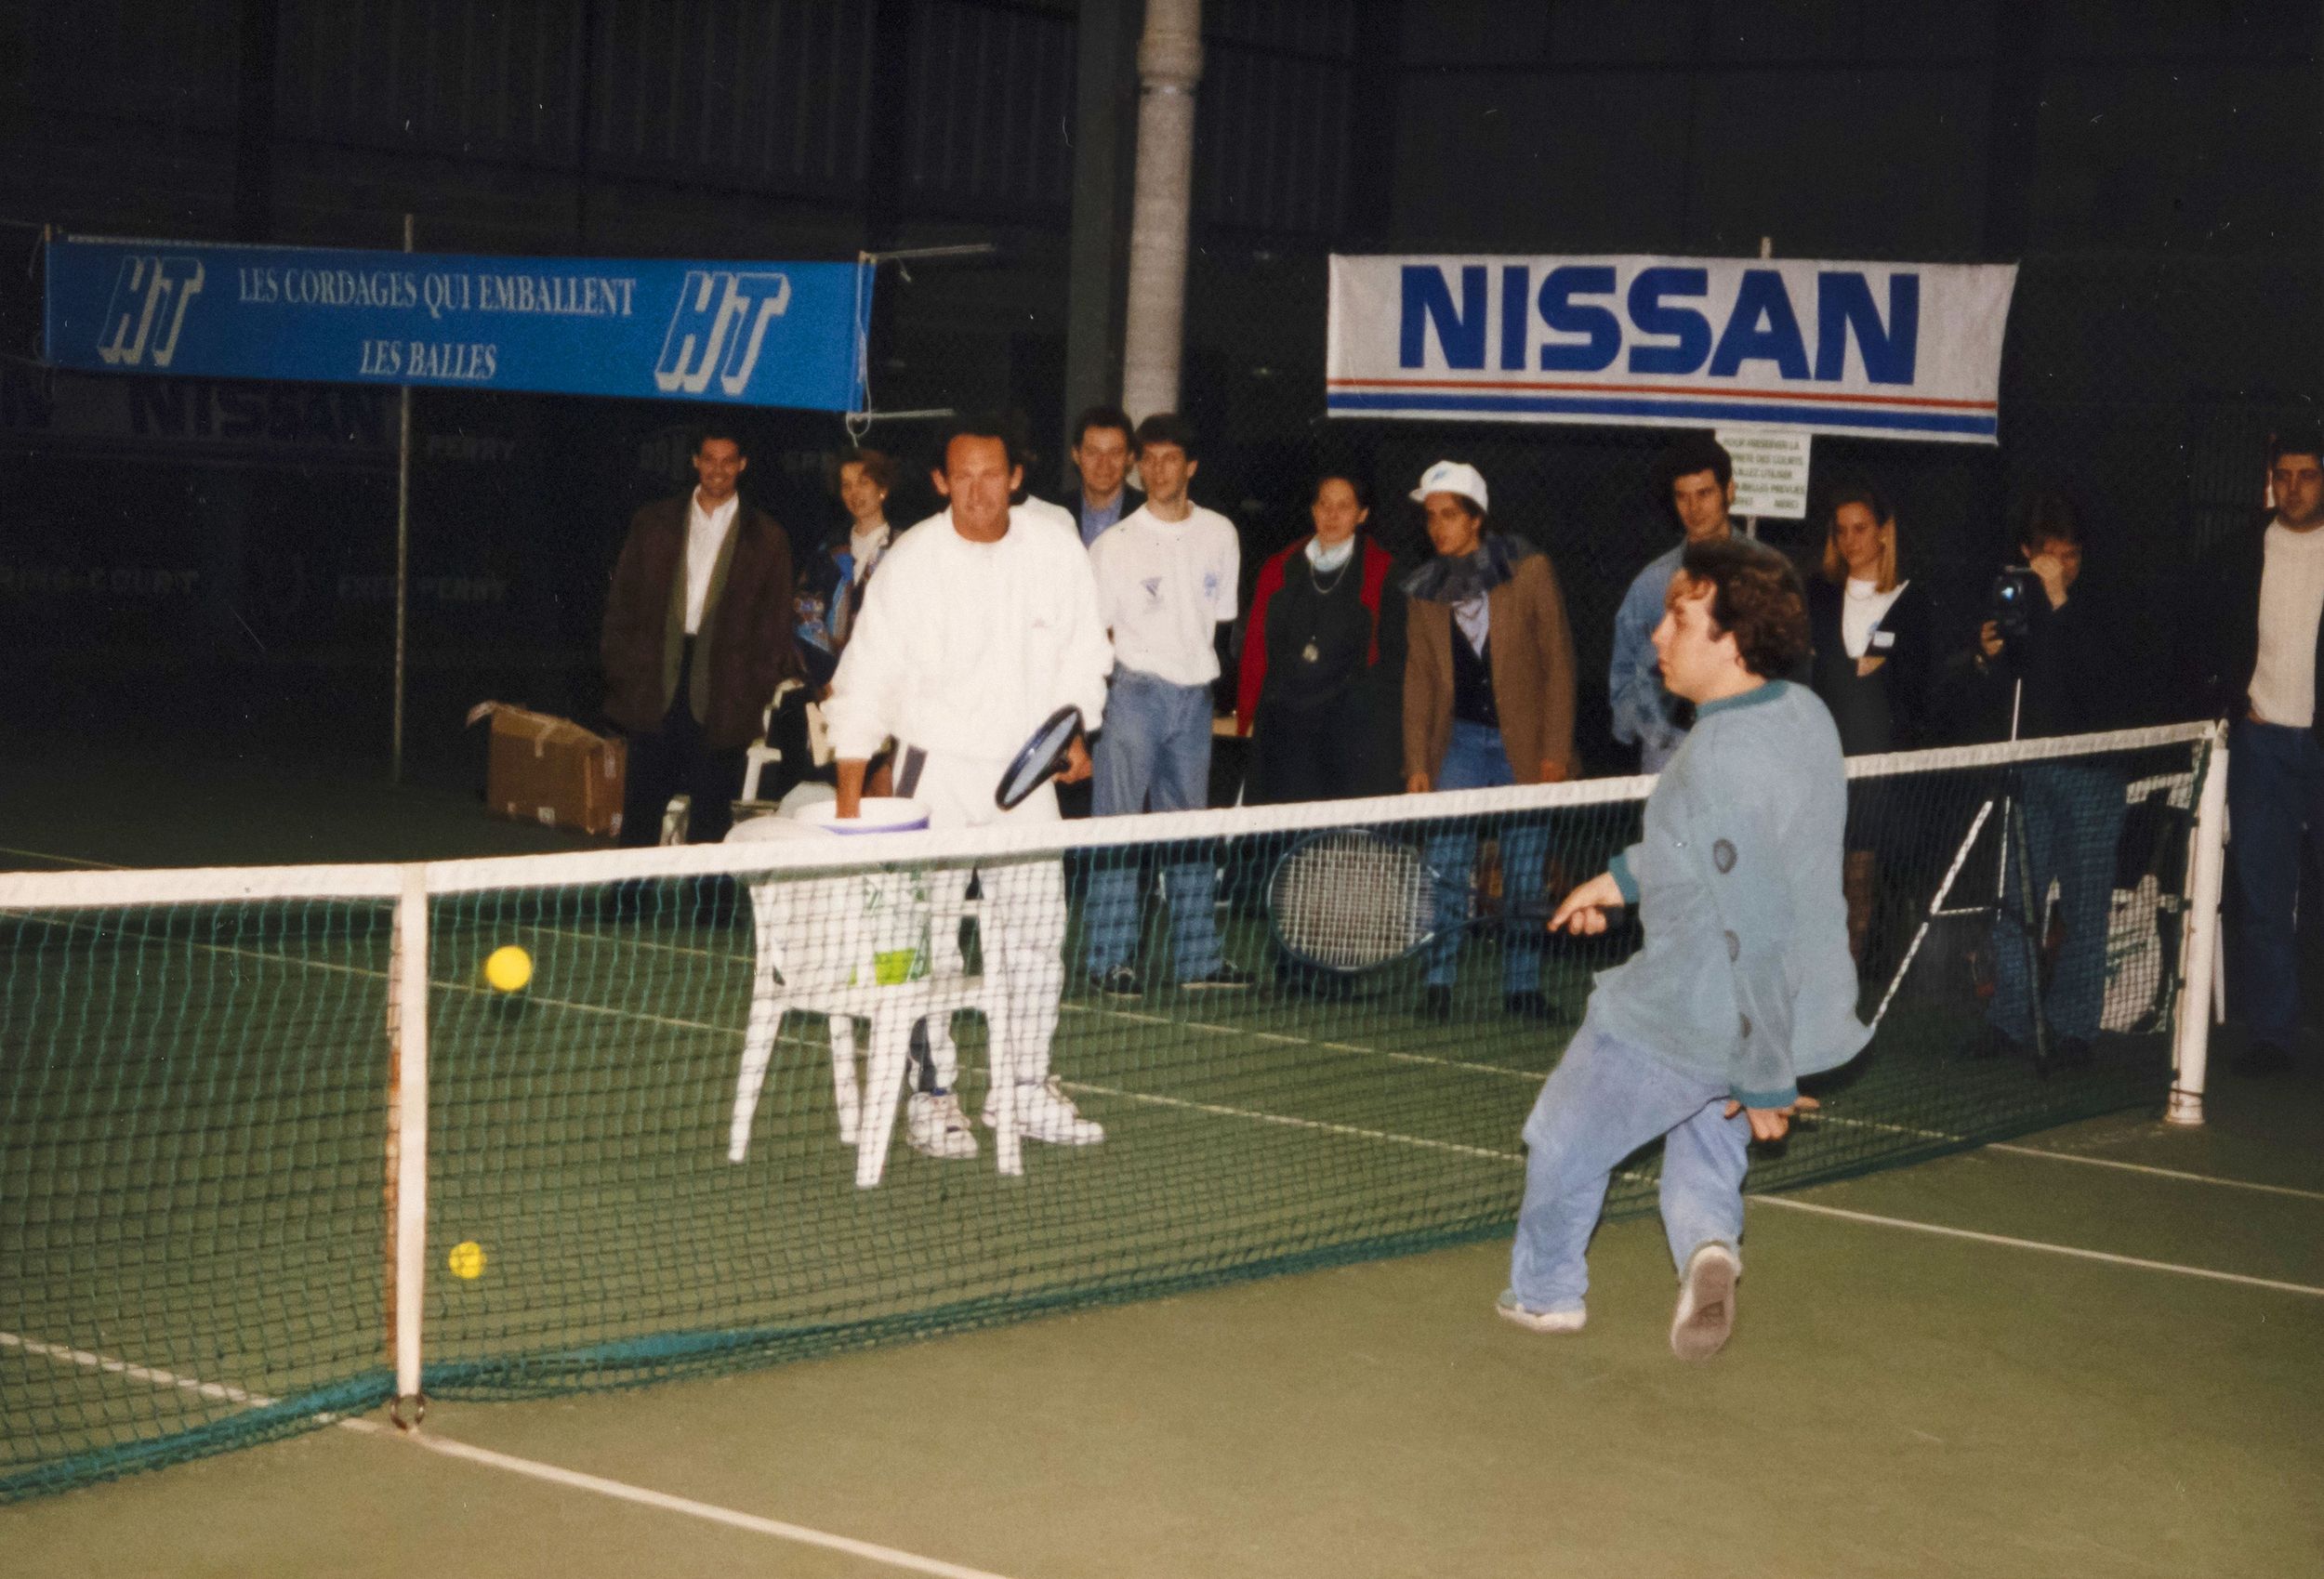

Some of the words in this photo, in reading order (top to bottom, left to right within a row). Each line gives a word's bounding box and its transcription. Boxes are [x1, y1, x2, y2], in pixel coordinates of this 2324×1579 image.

[238, 268, 278, 303] LES
[283, 269, 417, 309] CORDAGES
[423, 272, 470, 320] QUI
[479, 275, 637, 317] EMBALLENT
[1399, 264, 1920, 386] NISSAN
[359, 340, 403, 376] LES
[406, 341, 497, 381] BALLES
